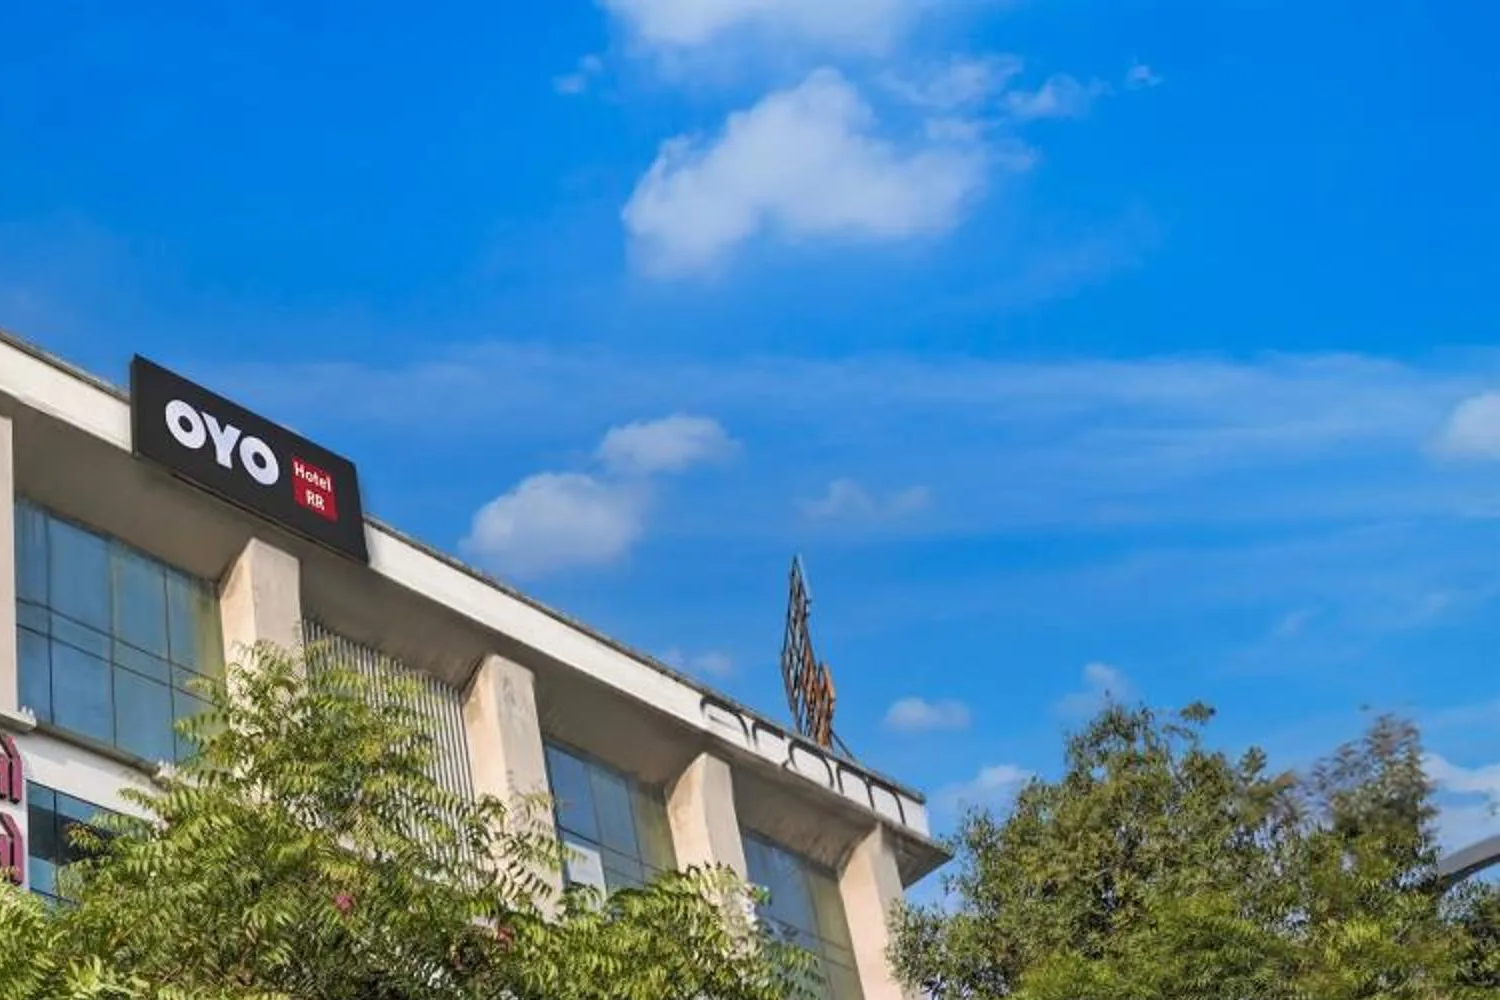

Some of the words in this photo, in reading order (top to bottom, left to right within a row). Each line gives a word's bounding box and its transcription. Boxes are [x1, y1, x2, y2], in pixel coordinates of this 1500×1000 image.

[166, 400, 279, 485] OYO
[295, 461, 332, 492] Hotel
[306, 490, 325, 511] RR
